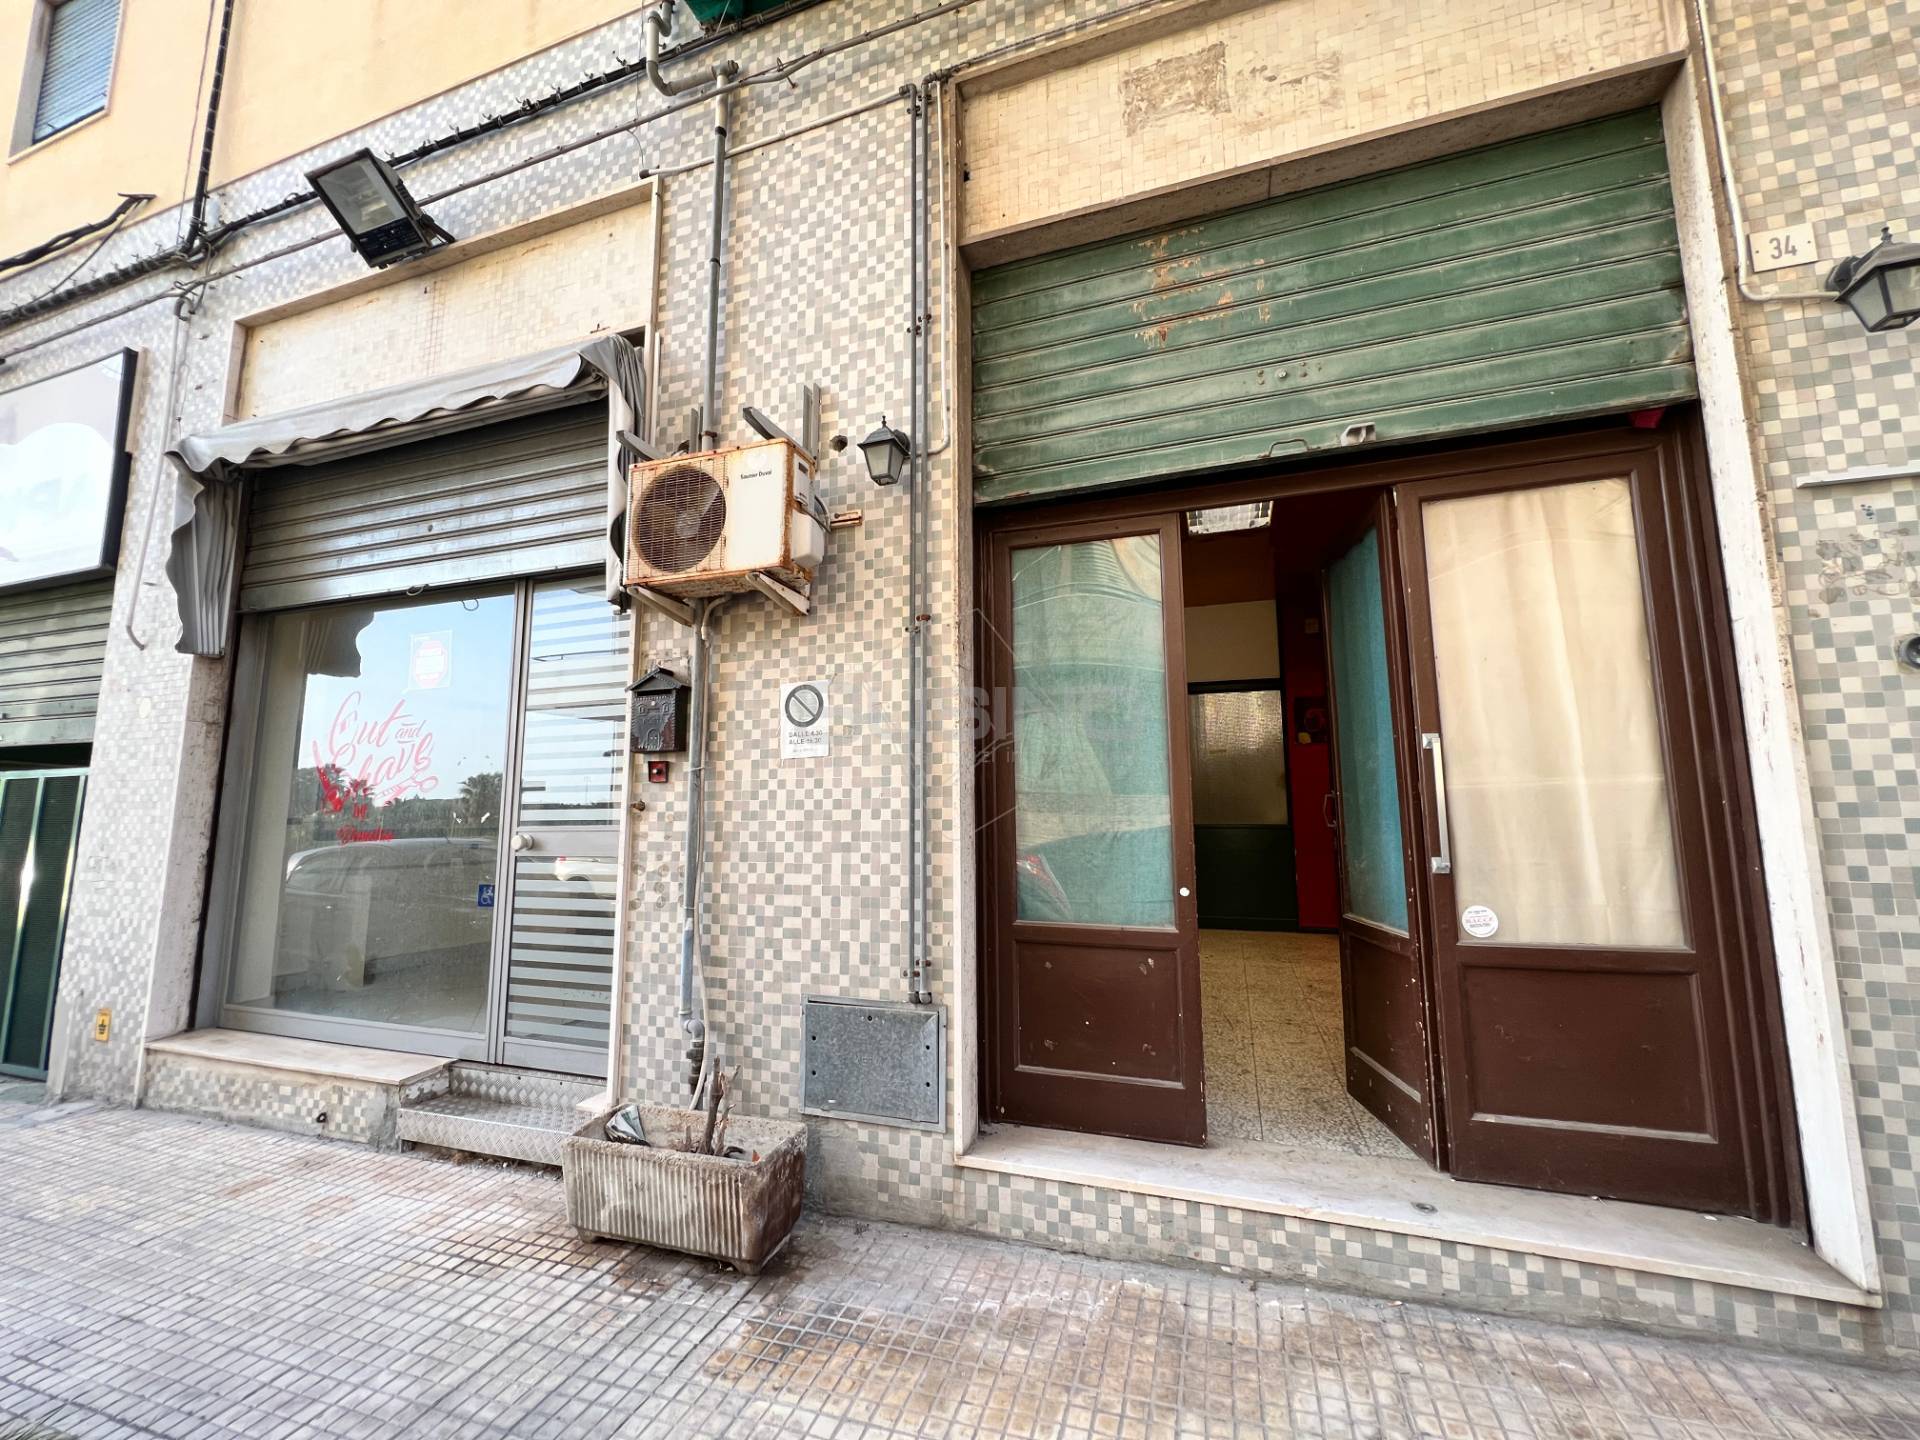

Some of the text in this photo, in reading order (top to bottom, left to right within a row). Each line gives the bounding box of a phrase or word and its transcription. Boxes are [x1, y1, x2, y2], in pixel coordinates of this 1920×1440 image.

[1768, 234, 1798, 260] 34
[328, 691, 427, 757] Cut and
